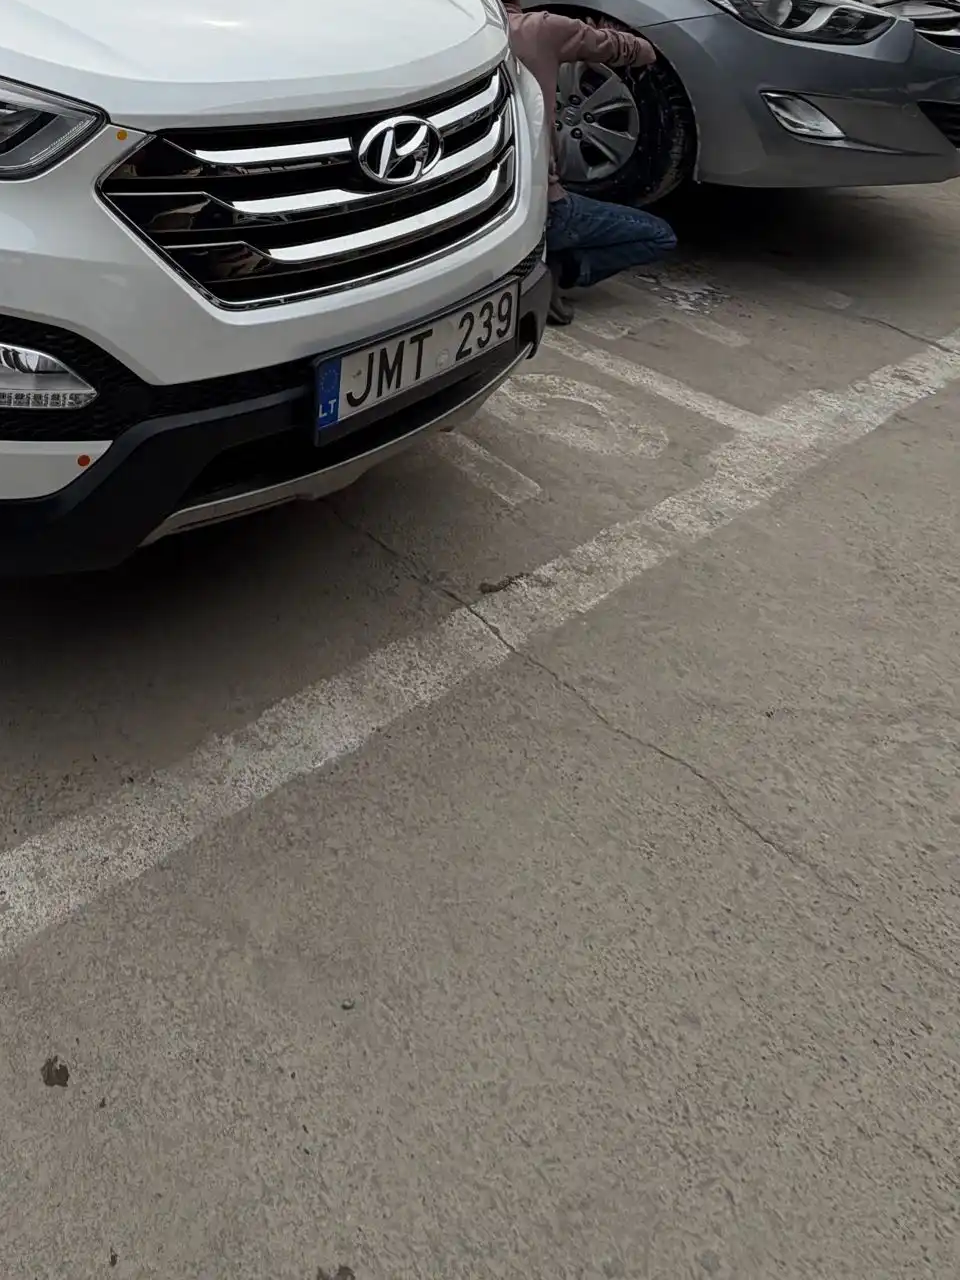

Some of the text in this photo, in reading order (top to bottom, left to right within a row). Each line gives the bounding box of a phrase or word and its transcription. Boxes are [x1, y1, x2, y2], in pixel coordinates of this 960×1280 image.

[346, 291, 513, 407] JMT 239
[318, 398, 337, 419] LT
